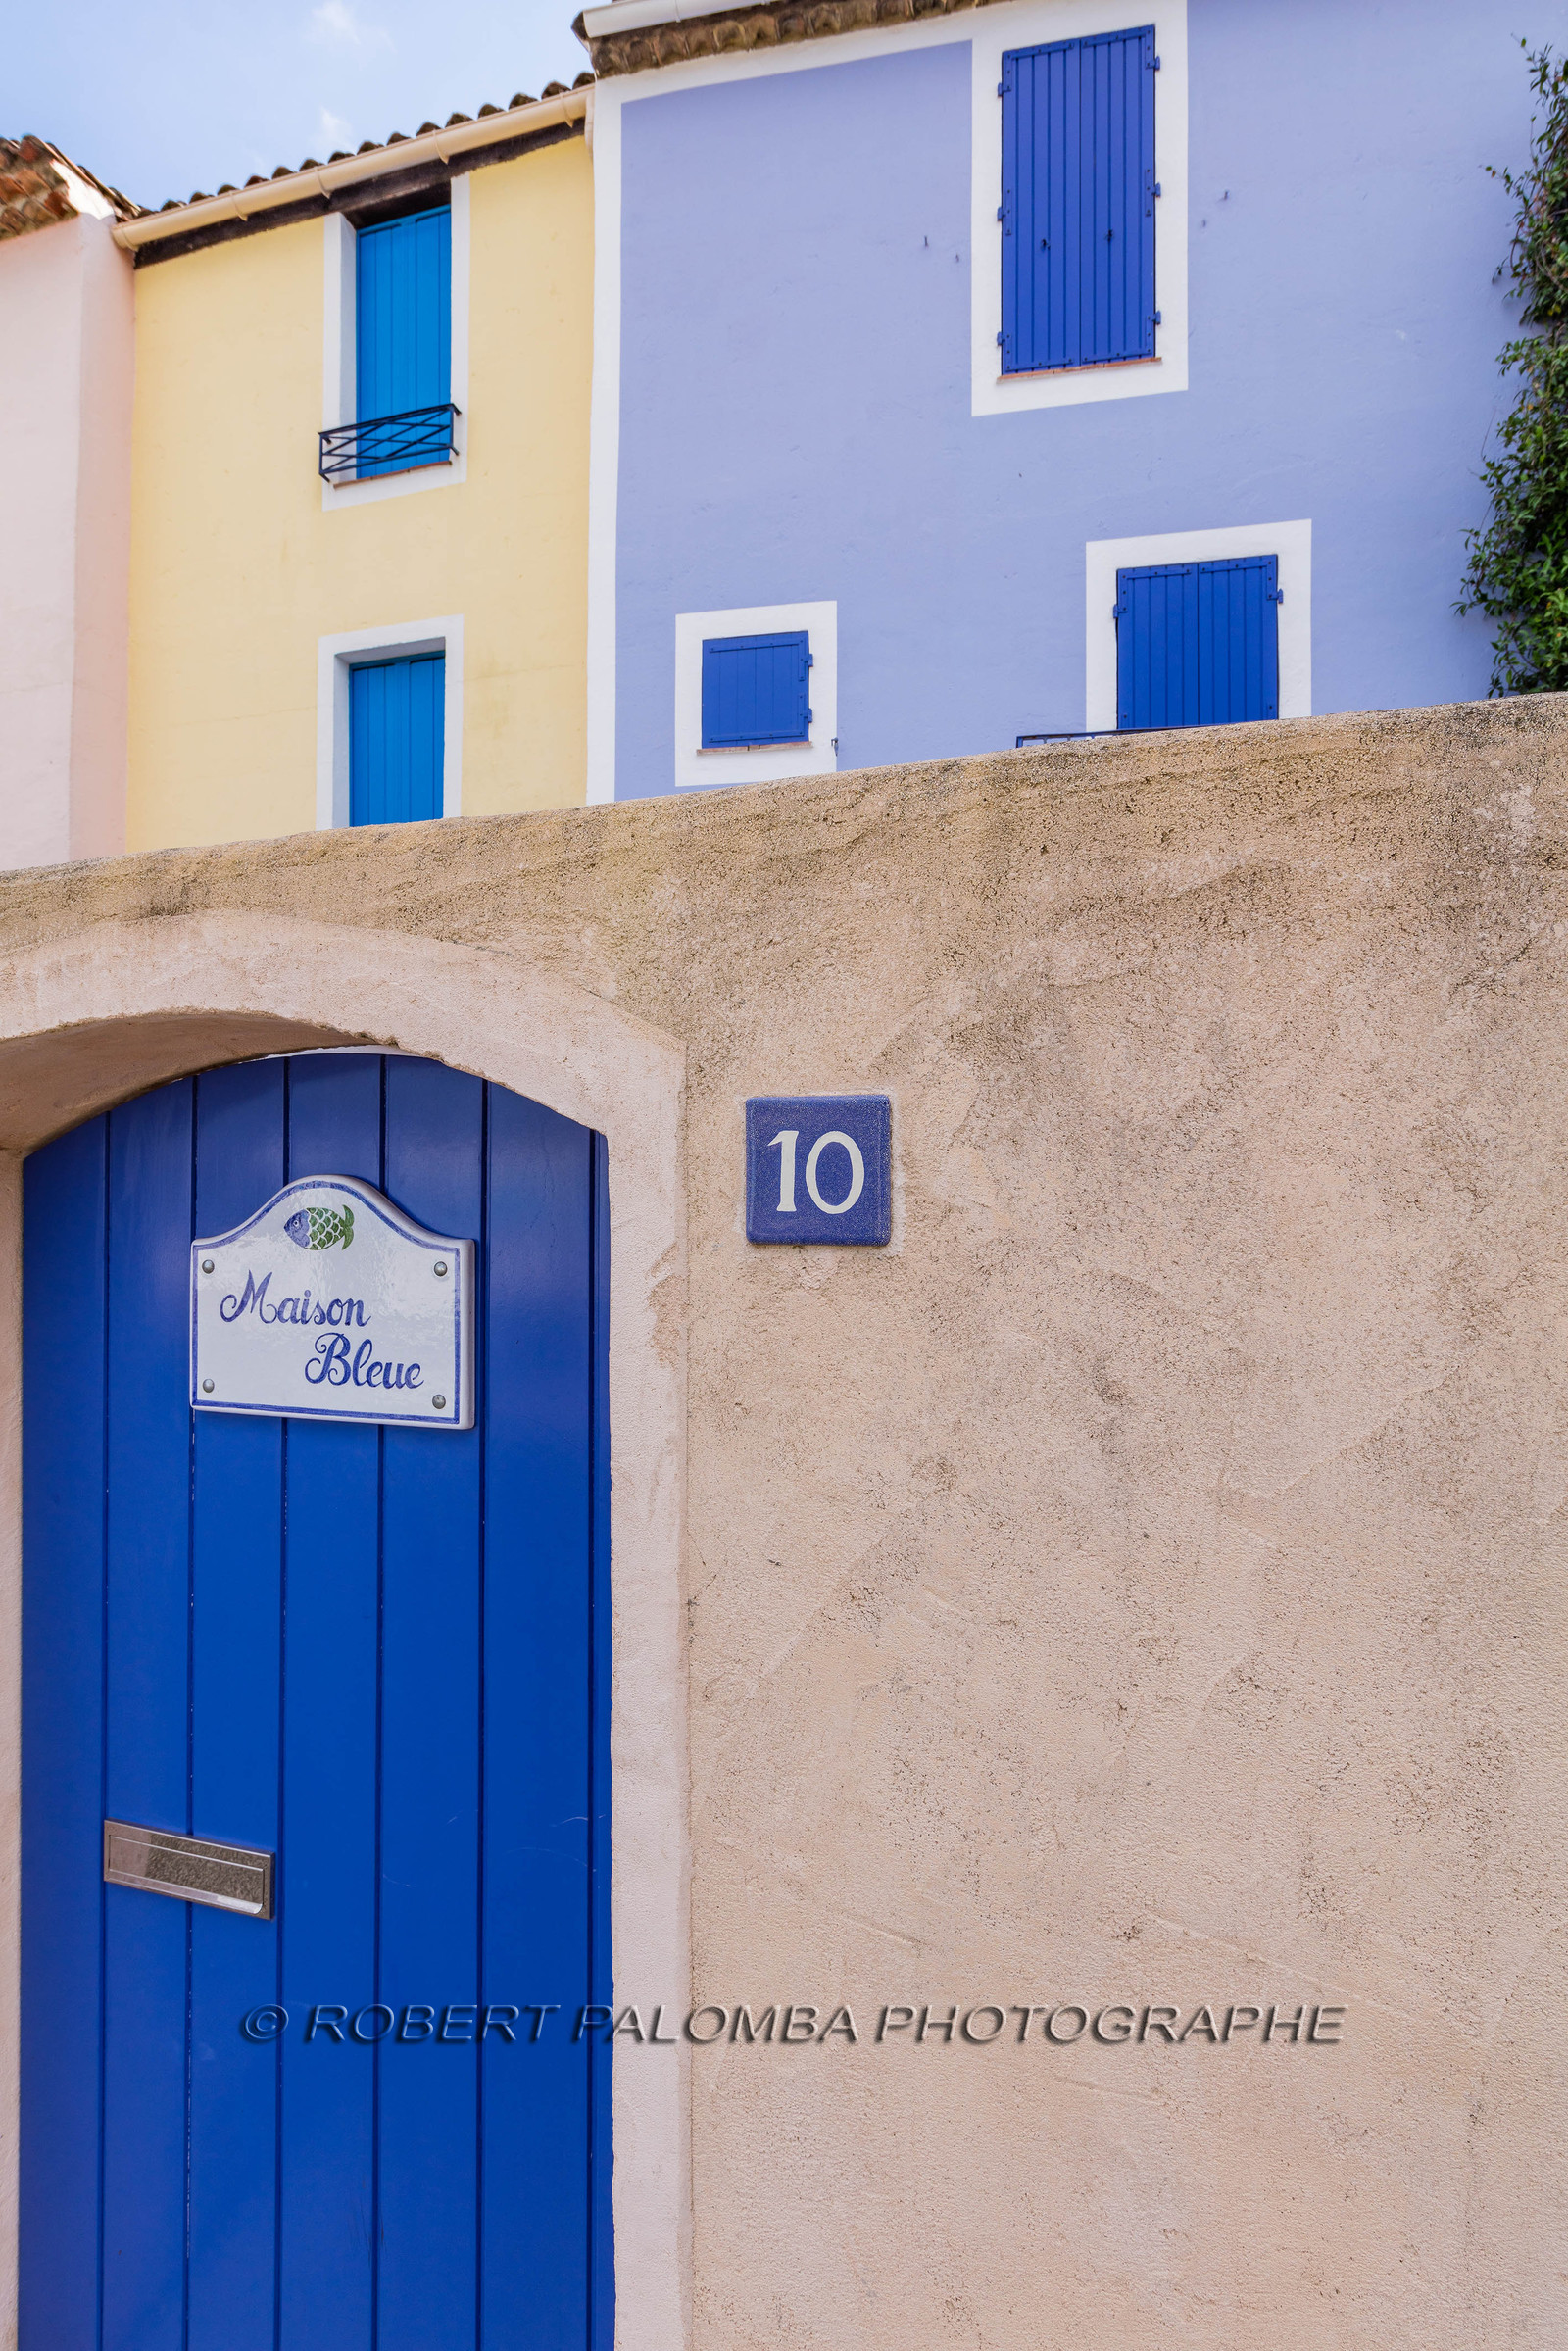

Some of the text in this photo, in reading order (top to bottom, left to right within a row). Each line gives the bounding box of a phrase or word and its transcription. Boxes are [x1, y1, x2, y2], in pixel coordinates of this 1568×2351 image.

[767, 1130, 865, 1214] 10
[219, 1269, 372, 1327] Maison
[304, 1332, 424, 1390] Bleue
